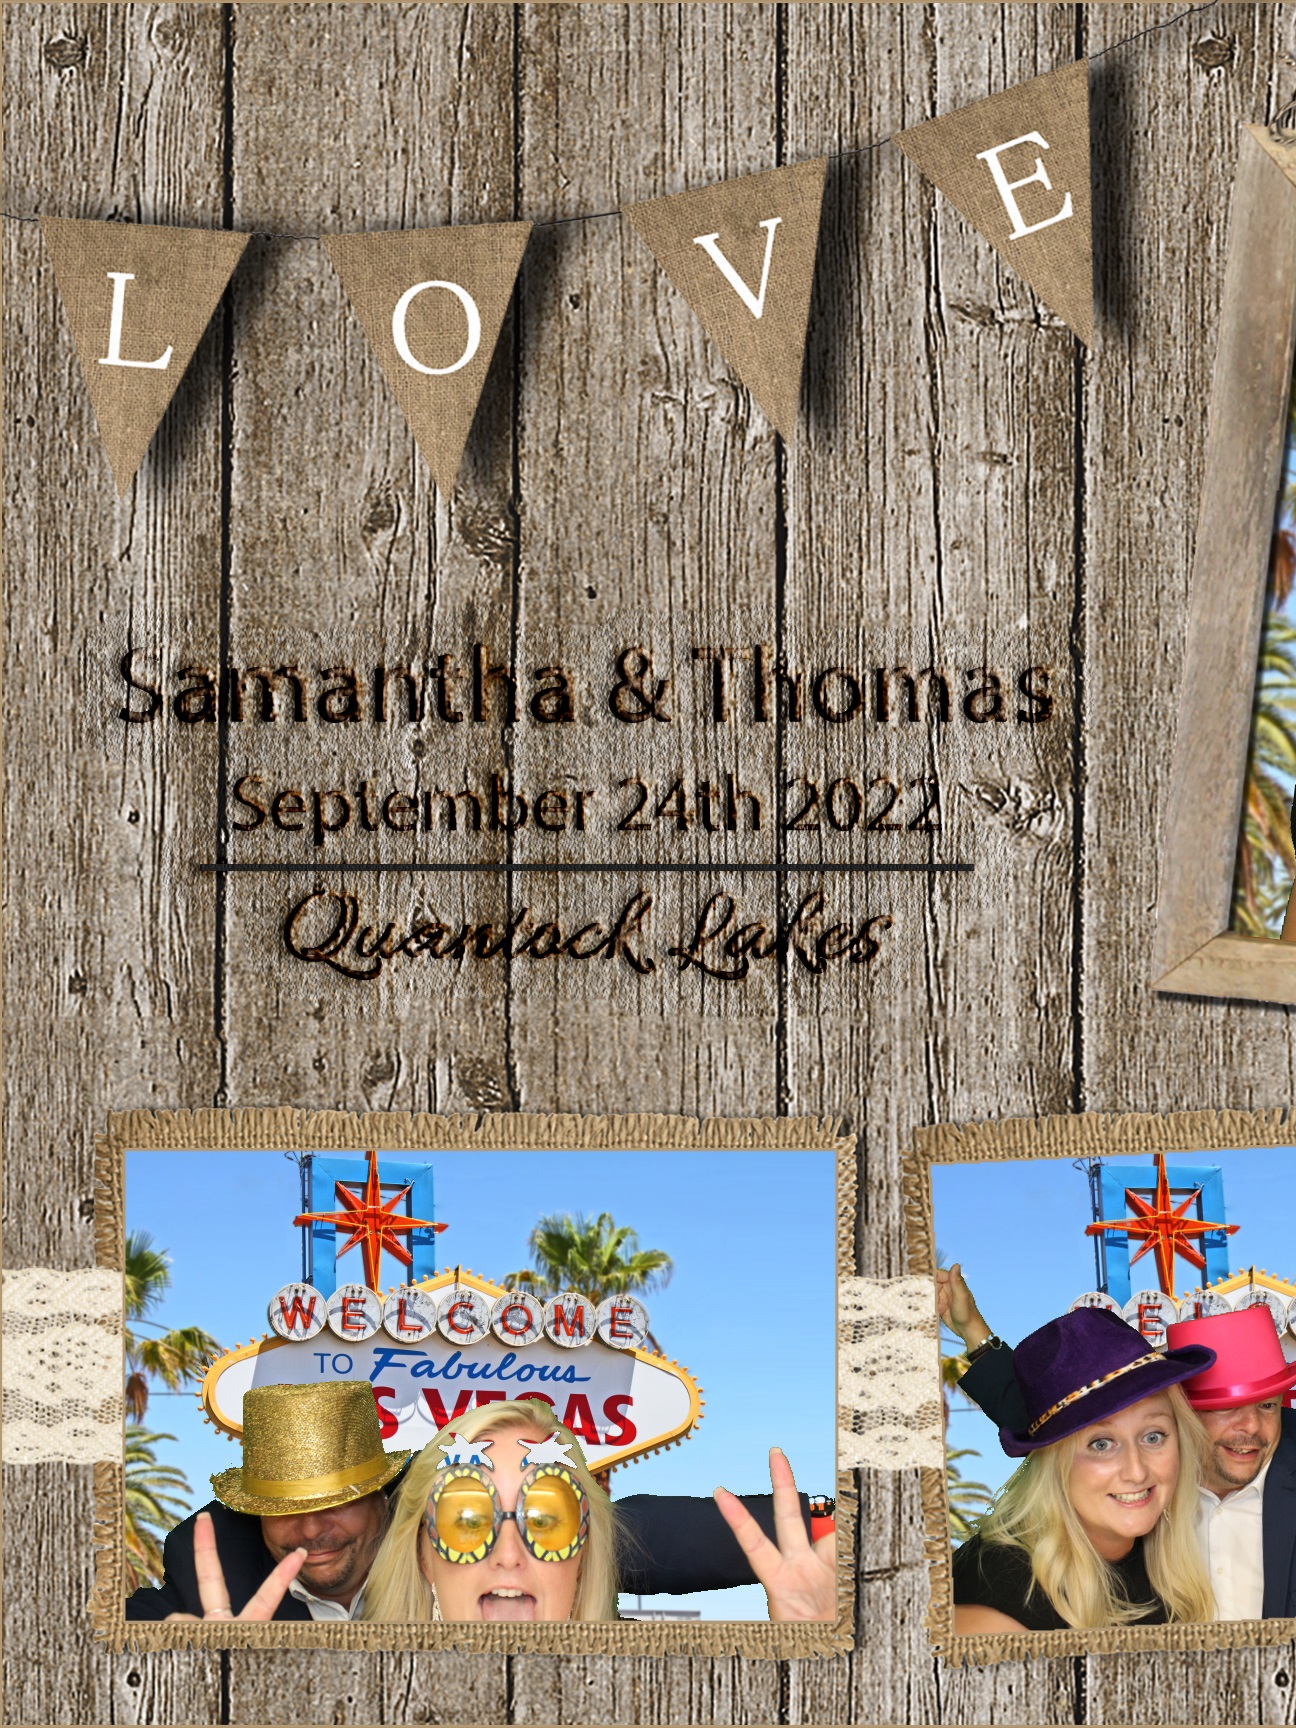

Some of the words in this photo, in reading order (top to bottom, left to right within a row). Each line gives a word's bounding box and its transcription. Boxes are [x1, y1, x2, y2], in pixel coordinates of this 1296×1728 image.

[279, 1295, 634, 1338] WELCOME
[313, 1352, 354, 1374] TO
[369, 1347, 592, 1383] Fabulous
